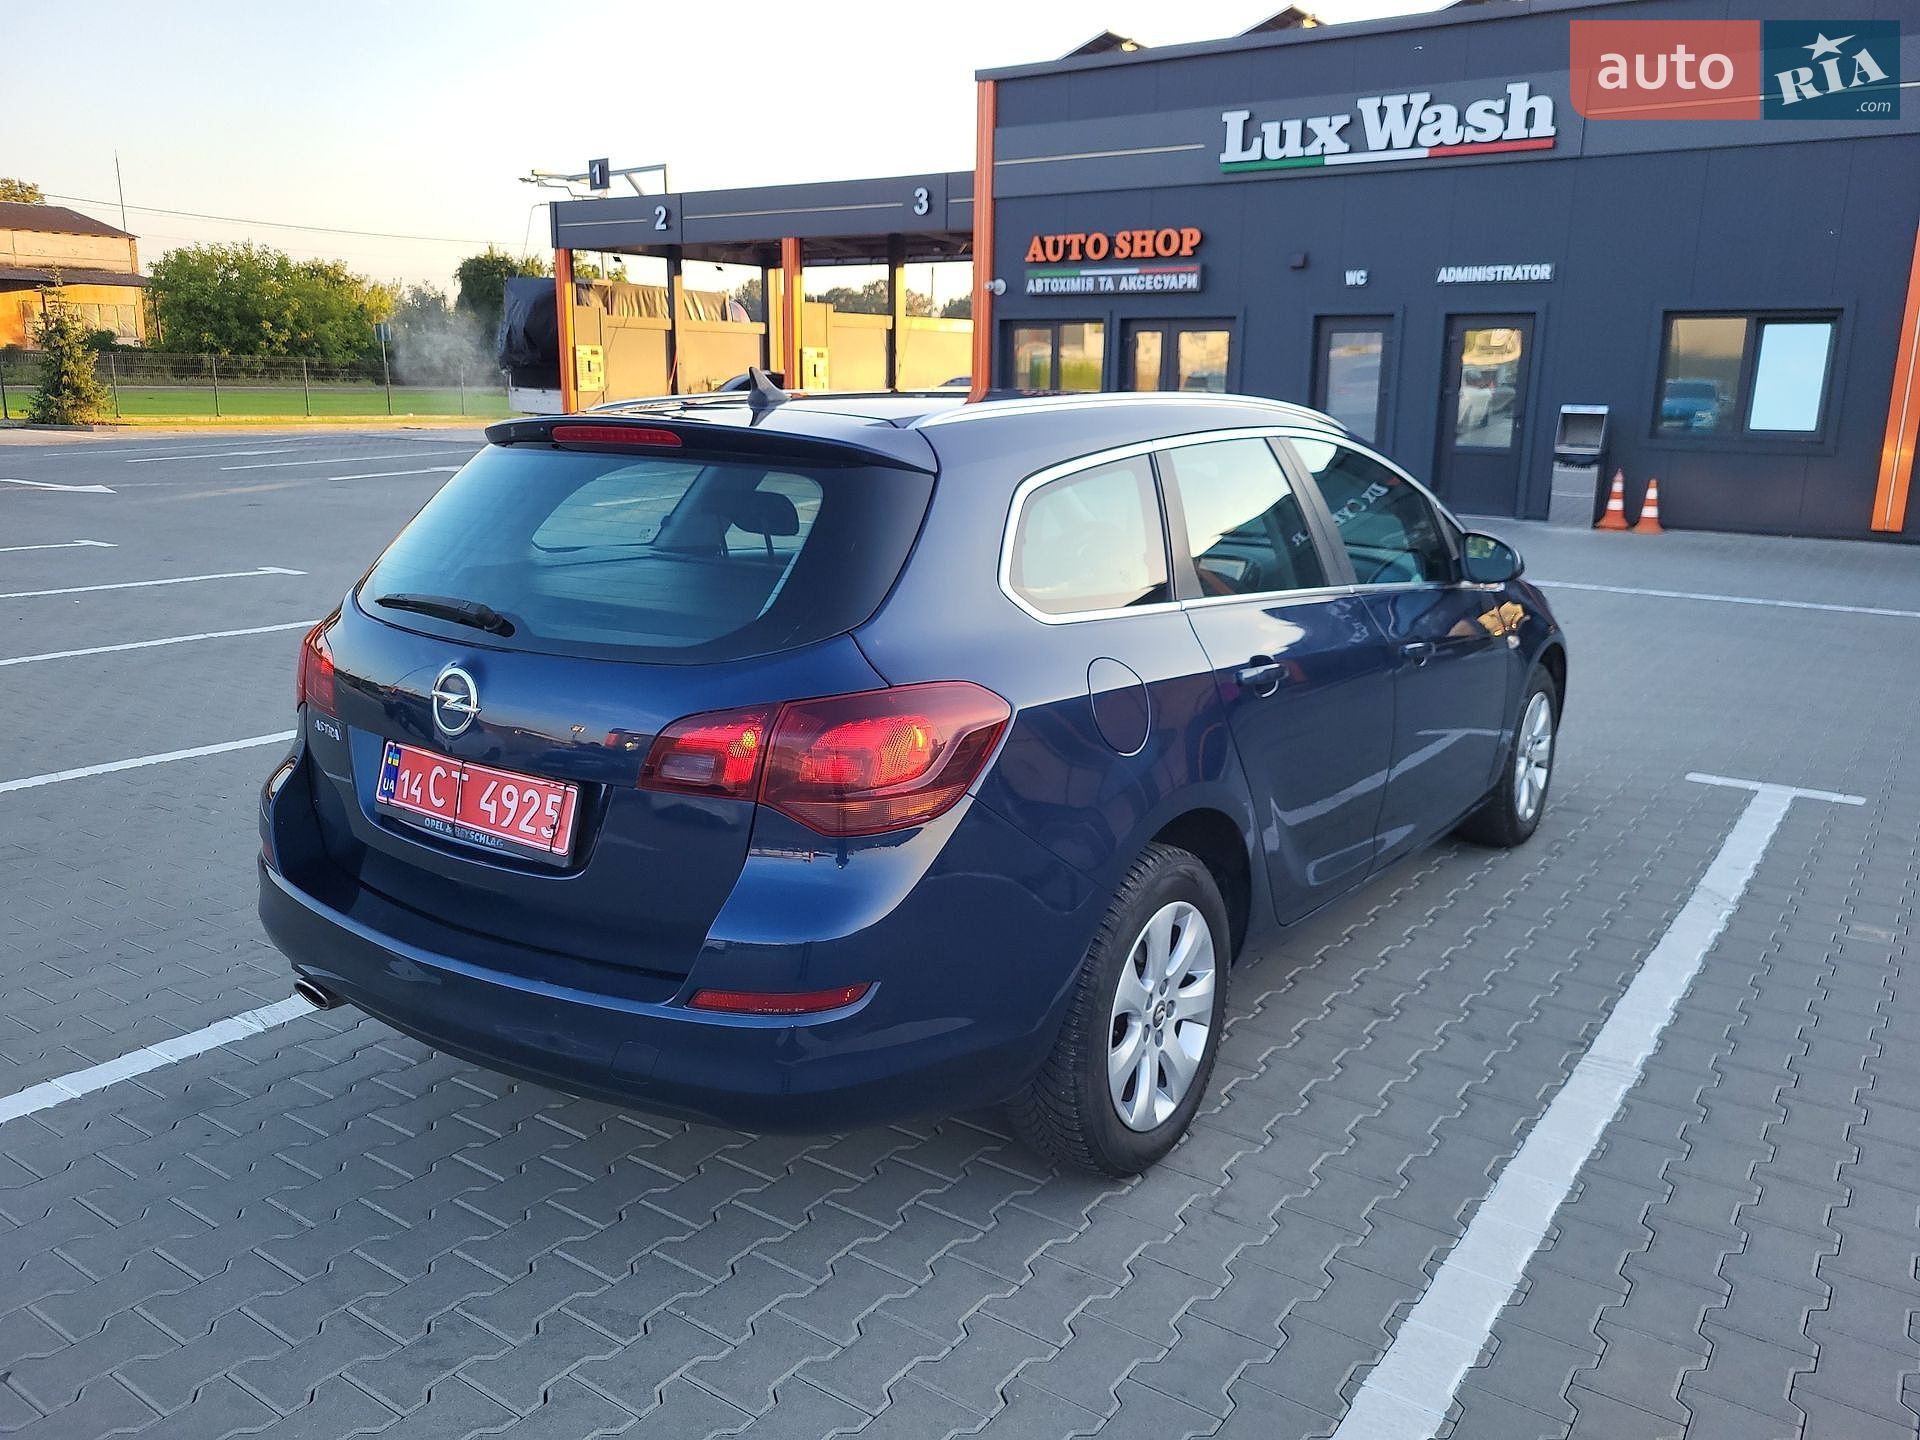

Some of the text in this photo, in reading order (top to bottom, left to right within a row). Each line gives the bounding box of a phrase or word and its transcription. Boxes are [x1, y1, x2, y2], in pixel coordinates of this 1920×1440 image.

[1220, 82, 1557, 163] Lux Wash
[592, 163, 601, 185] 1
[913, 187, 929, 216] 3
[654, 205, 667, 230] 2
[1024, 227, 1202, 263] AUTO SHOP
[1026, 273, 1198, 294] АВТОХІМІЯ ТА АКСЕСУАРИ
[1345, 269, 1368, 286] WC
[1437, 263, 1553, 283] ADMINISTRATOR
[382, 777, 395, 793] UA
[479, 780, 563, 839] 4925
[424, 817, 444, 832] OPEL
